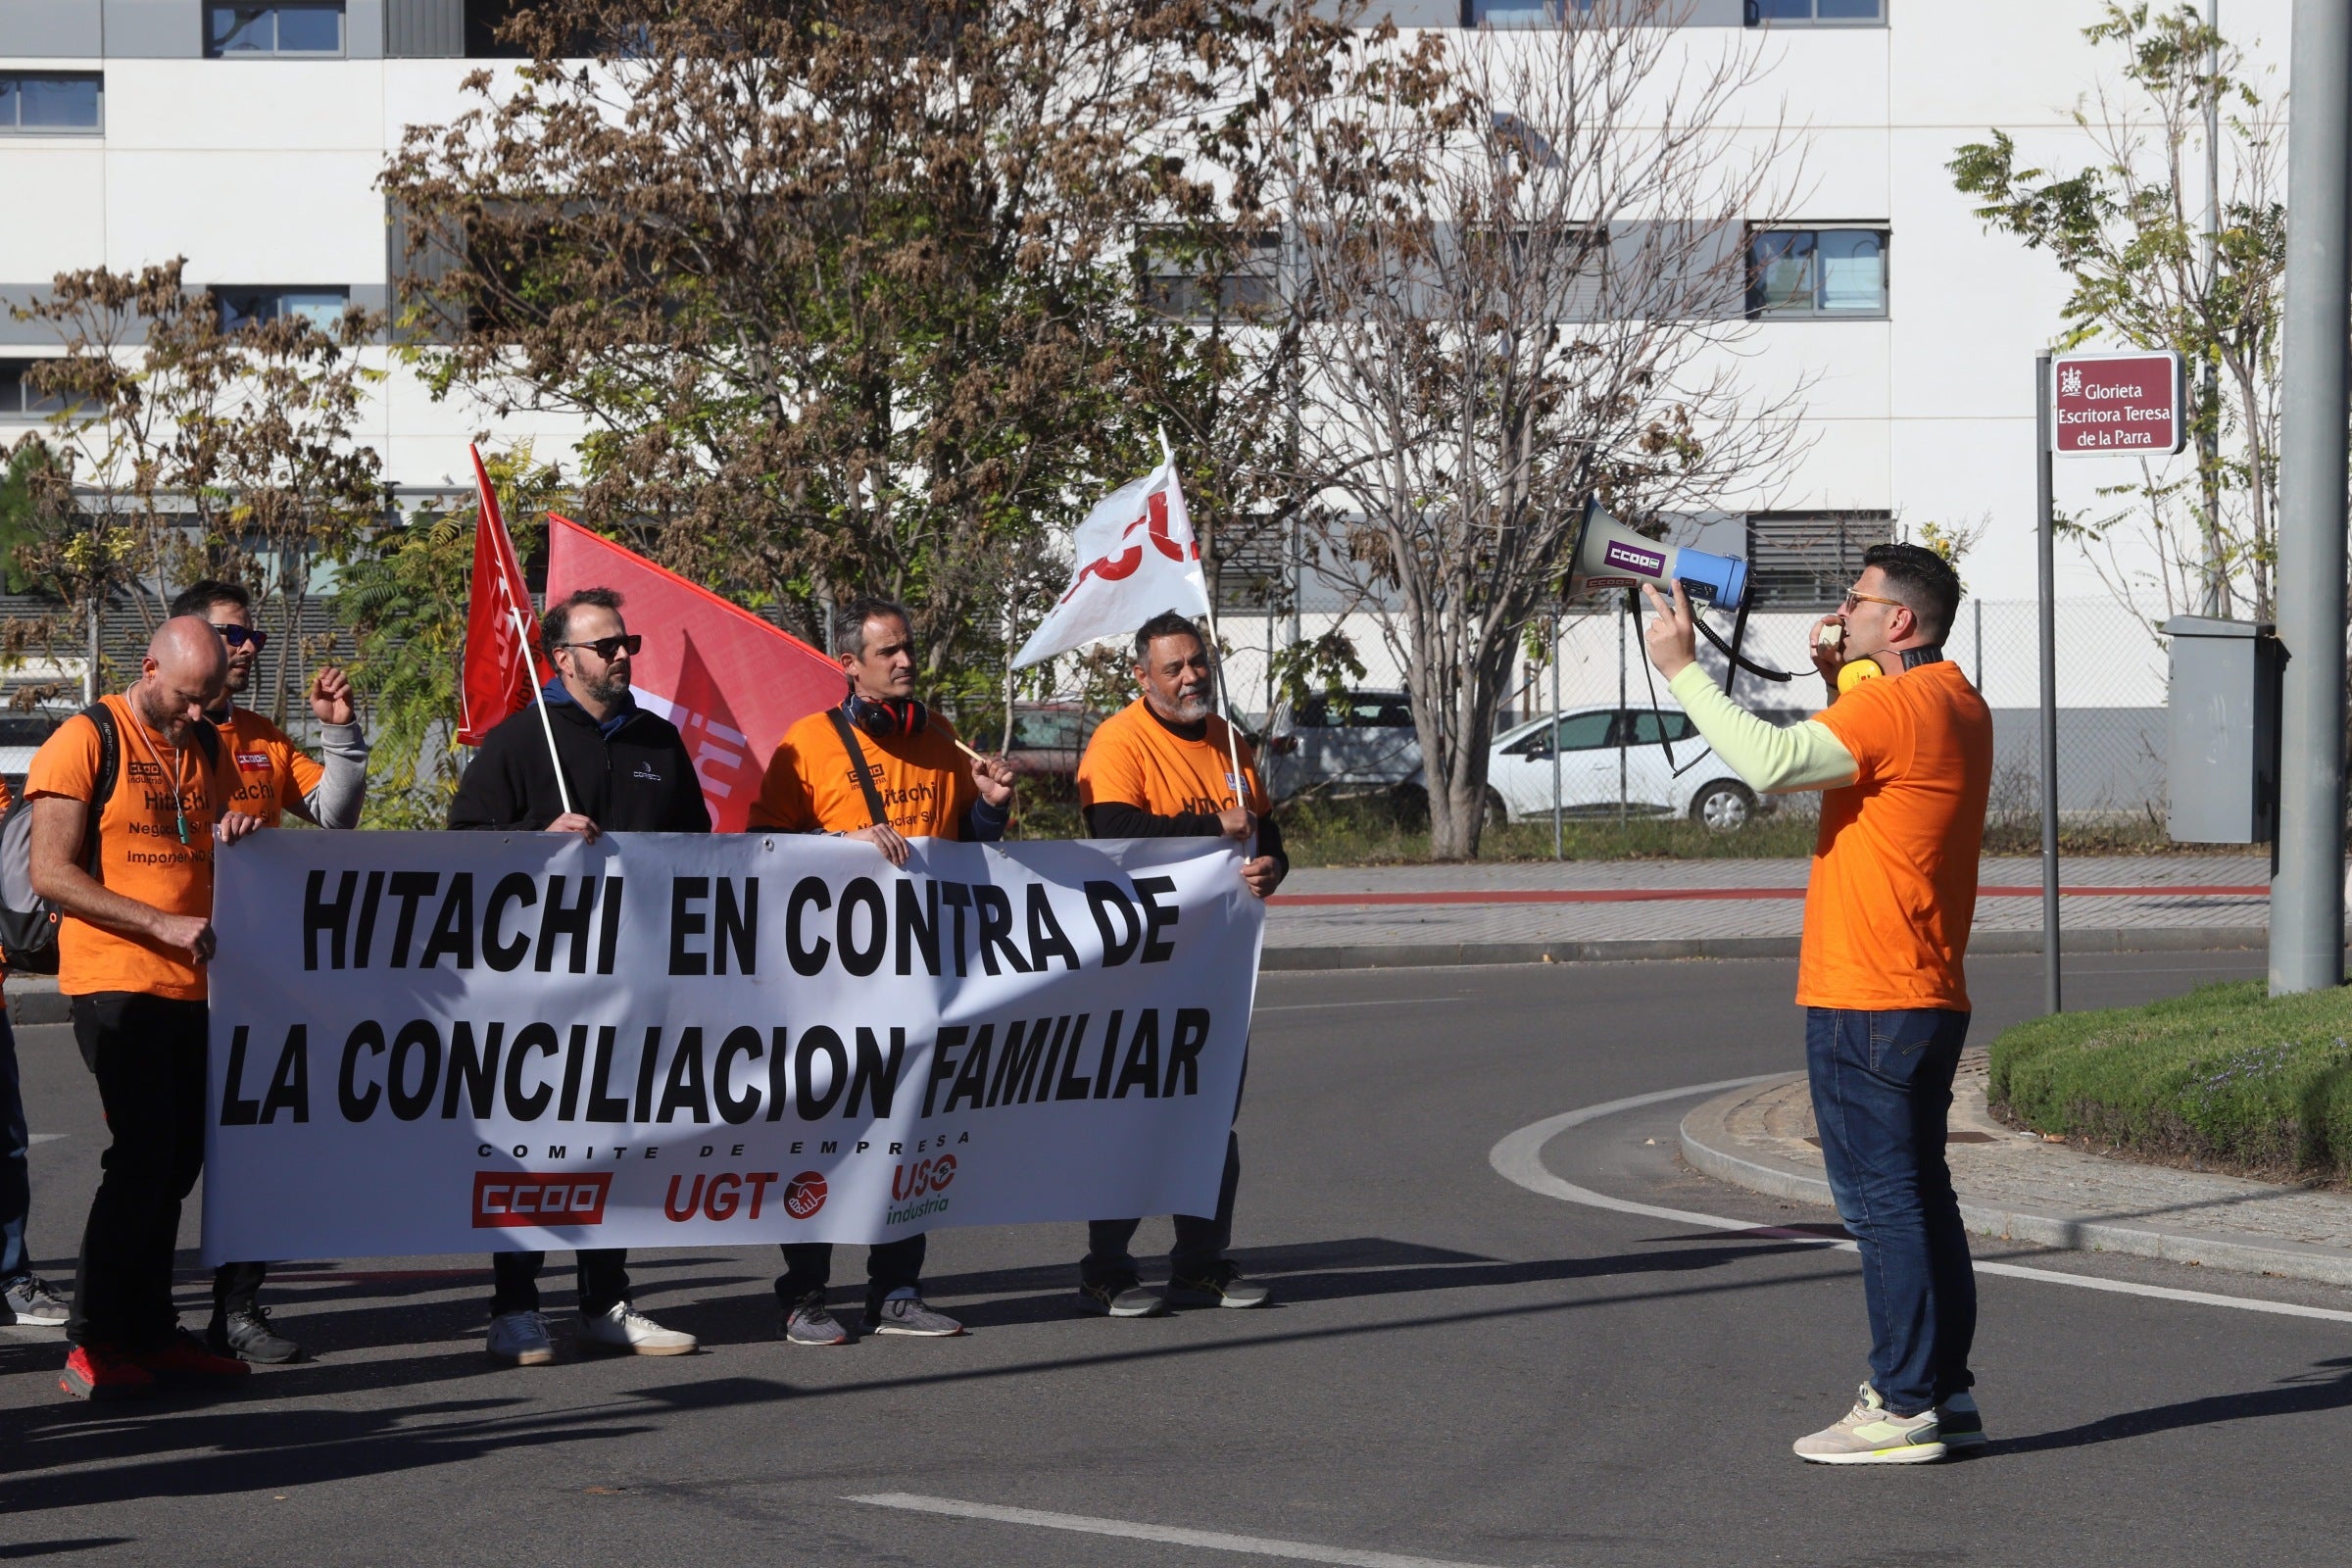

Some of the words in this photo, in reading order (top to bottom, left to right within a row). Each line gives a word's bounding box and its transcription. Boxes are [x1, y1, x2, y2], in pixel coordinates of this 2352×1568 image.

[2084, 384, 2143, 400] Glorieta
[2058, 408, 2121, 424] Escritora
[2124, 406, 2171, 421] Teresa
[2077, 431, 2096, 446] de
[2099, 430, 2111, 445] la
[2115, 429, 2152, 445] Parra
[879, 782, 937, 807] itachi
[127, 850, 189, 865] Imponer
[303, 869, 624, 975] HITACHI
[667, 876, 760, 976] EN
[785, 875, 1081, 978] CONTRA
[1083, 875, 1180, 968] DE
[219, 1024, 310, 1126] LA
[337, 1019, 906, 1125] CONCILIACION
[921, 1007, 1211, 1119] FAMILIAR
[477, 1144, 660, 1159] COMITE
[699, 1144, 745, 1157] DE
[789, 1131, 970, 1155] EMPRESA
[481, 1184, 601, 1214] CCOO
[663, 1172, 779, 1223] UGT
[892, 1153, 957, 1201] USO
[886, 1194, 950, 1225] industria
